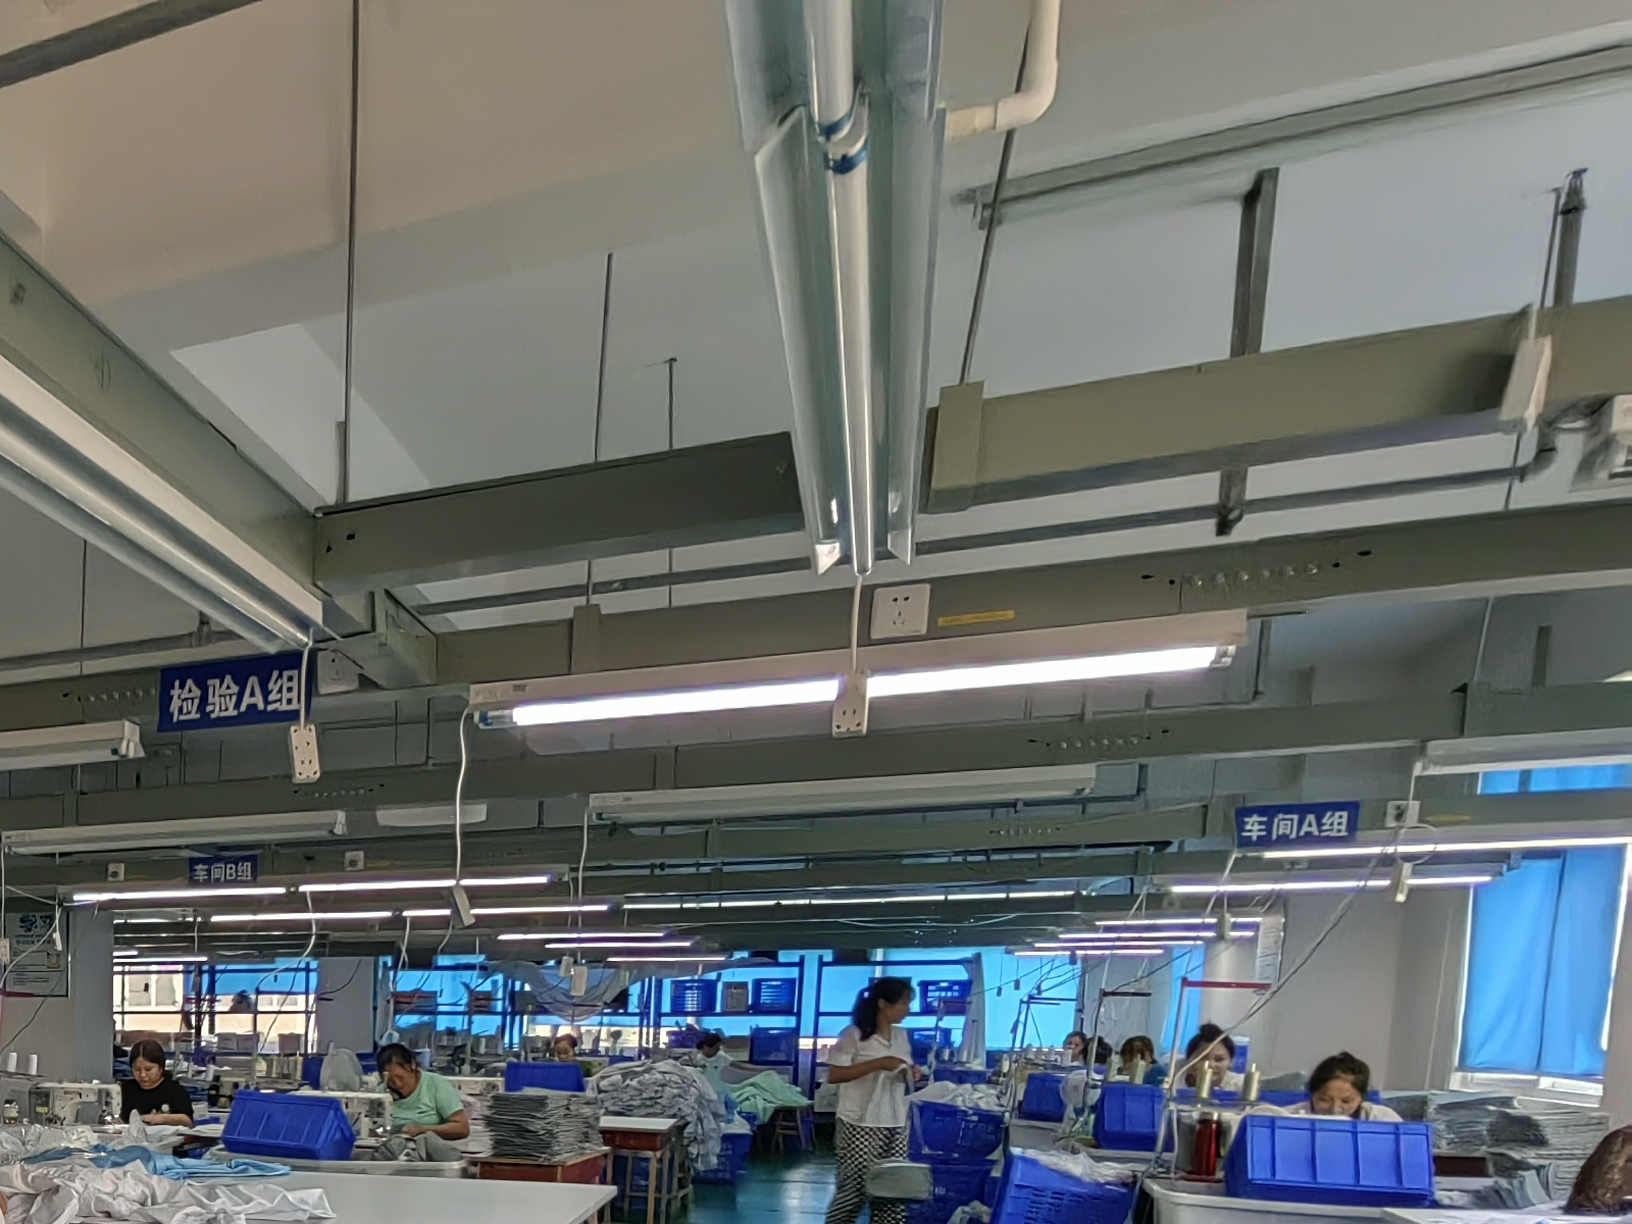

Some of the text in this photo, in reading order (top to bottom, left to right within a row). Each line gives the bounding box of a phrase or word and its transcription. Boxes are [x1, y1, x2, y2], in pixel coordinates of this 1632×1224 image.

[169, 669, 302, 723] 检验A组
[1241, 811, 1349, 841] 车间A组
[193, 862, 252, 882] 车间B组
